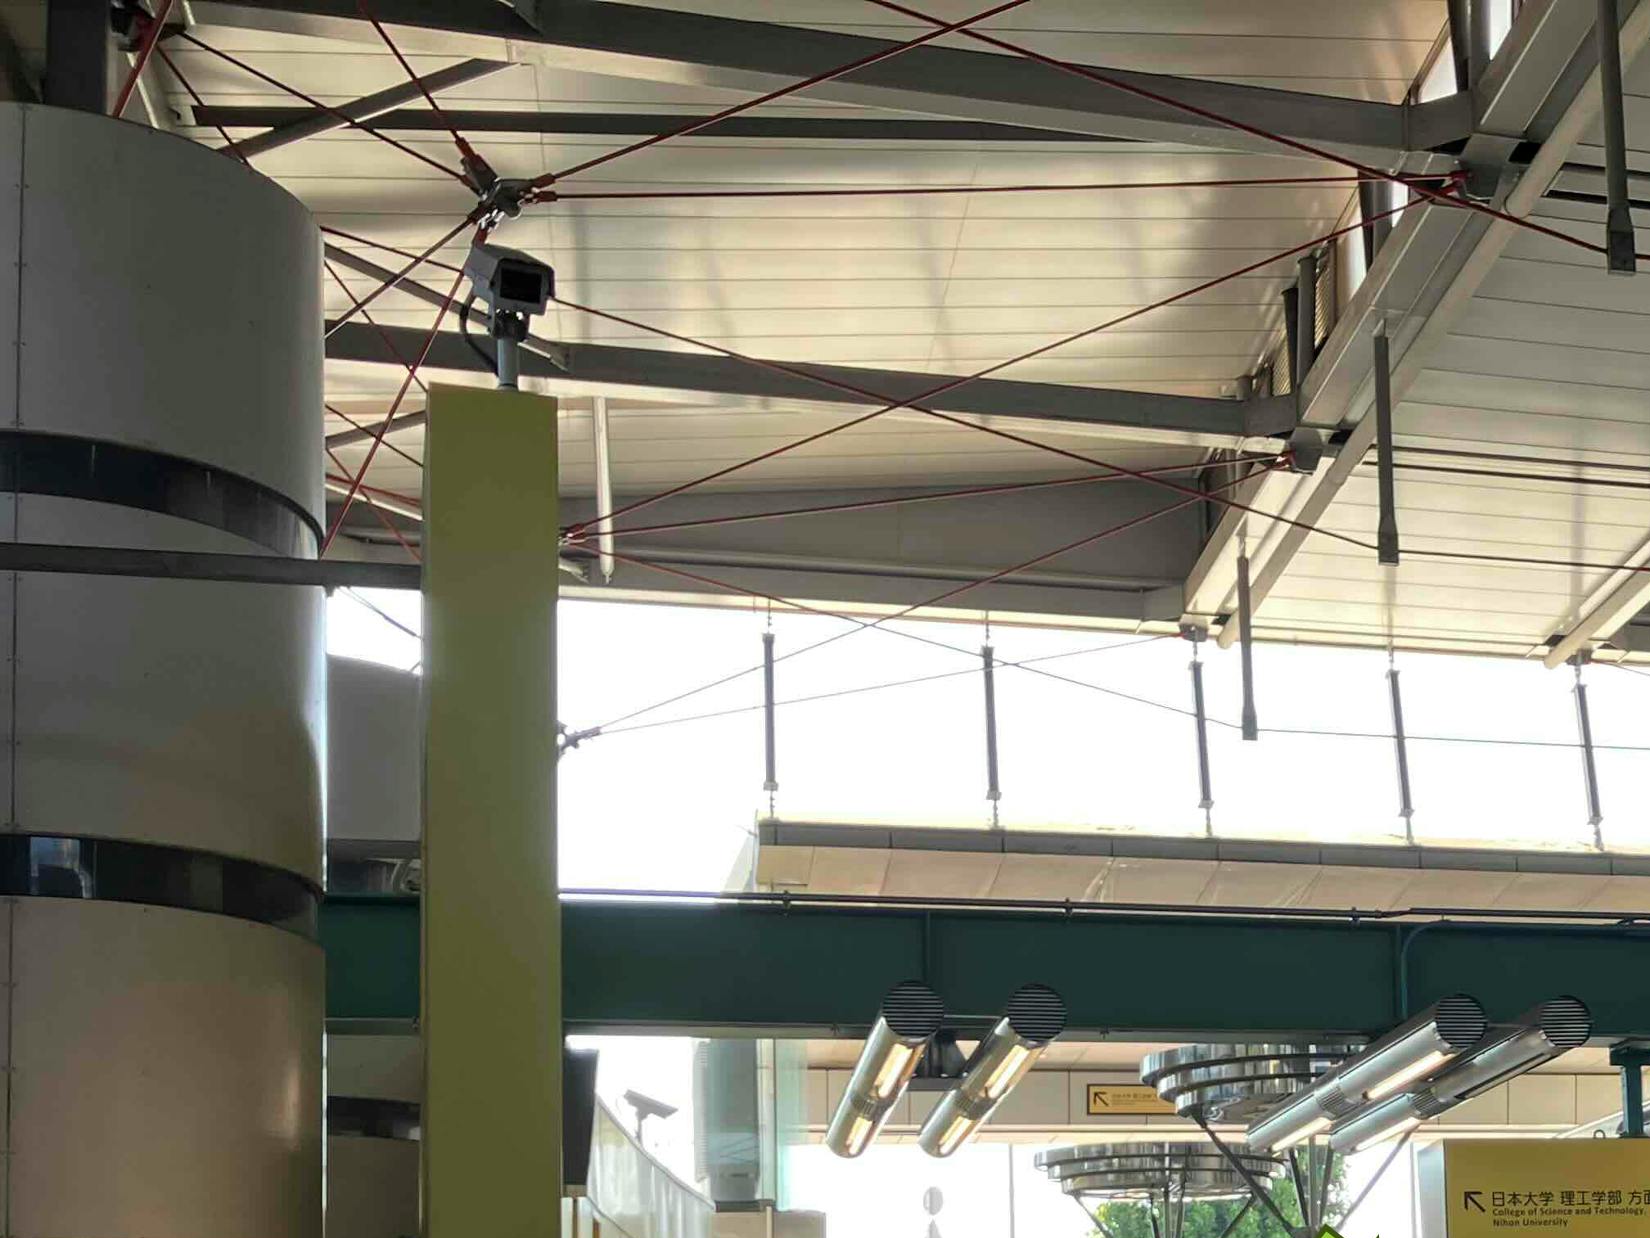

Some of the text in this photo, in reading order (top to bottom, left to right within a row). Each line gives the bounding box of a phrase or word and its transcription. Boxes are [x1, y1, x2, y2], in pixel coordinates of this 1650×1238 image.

[1492, 1191, 1554, 1207] 日本大学
[1560, 1190, 1622, 1206] 理工学部
[1492, 1208, 1525, 1218] College
[1528, 1207, 1537, 1216] of
[1540, 1207, 1572, 1216] Science
[1575, 1206, 1592, 1215] and
[1493, 1217, 1568, 1228] Nihon University
